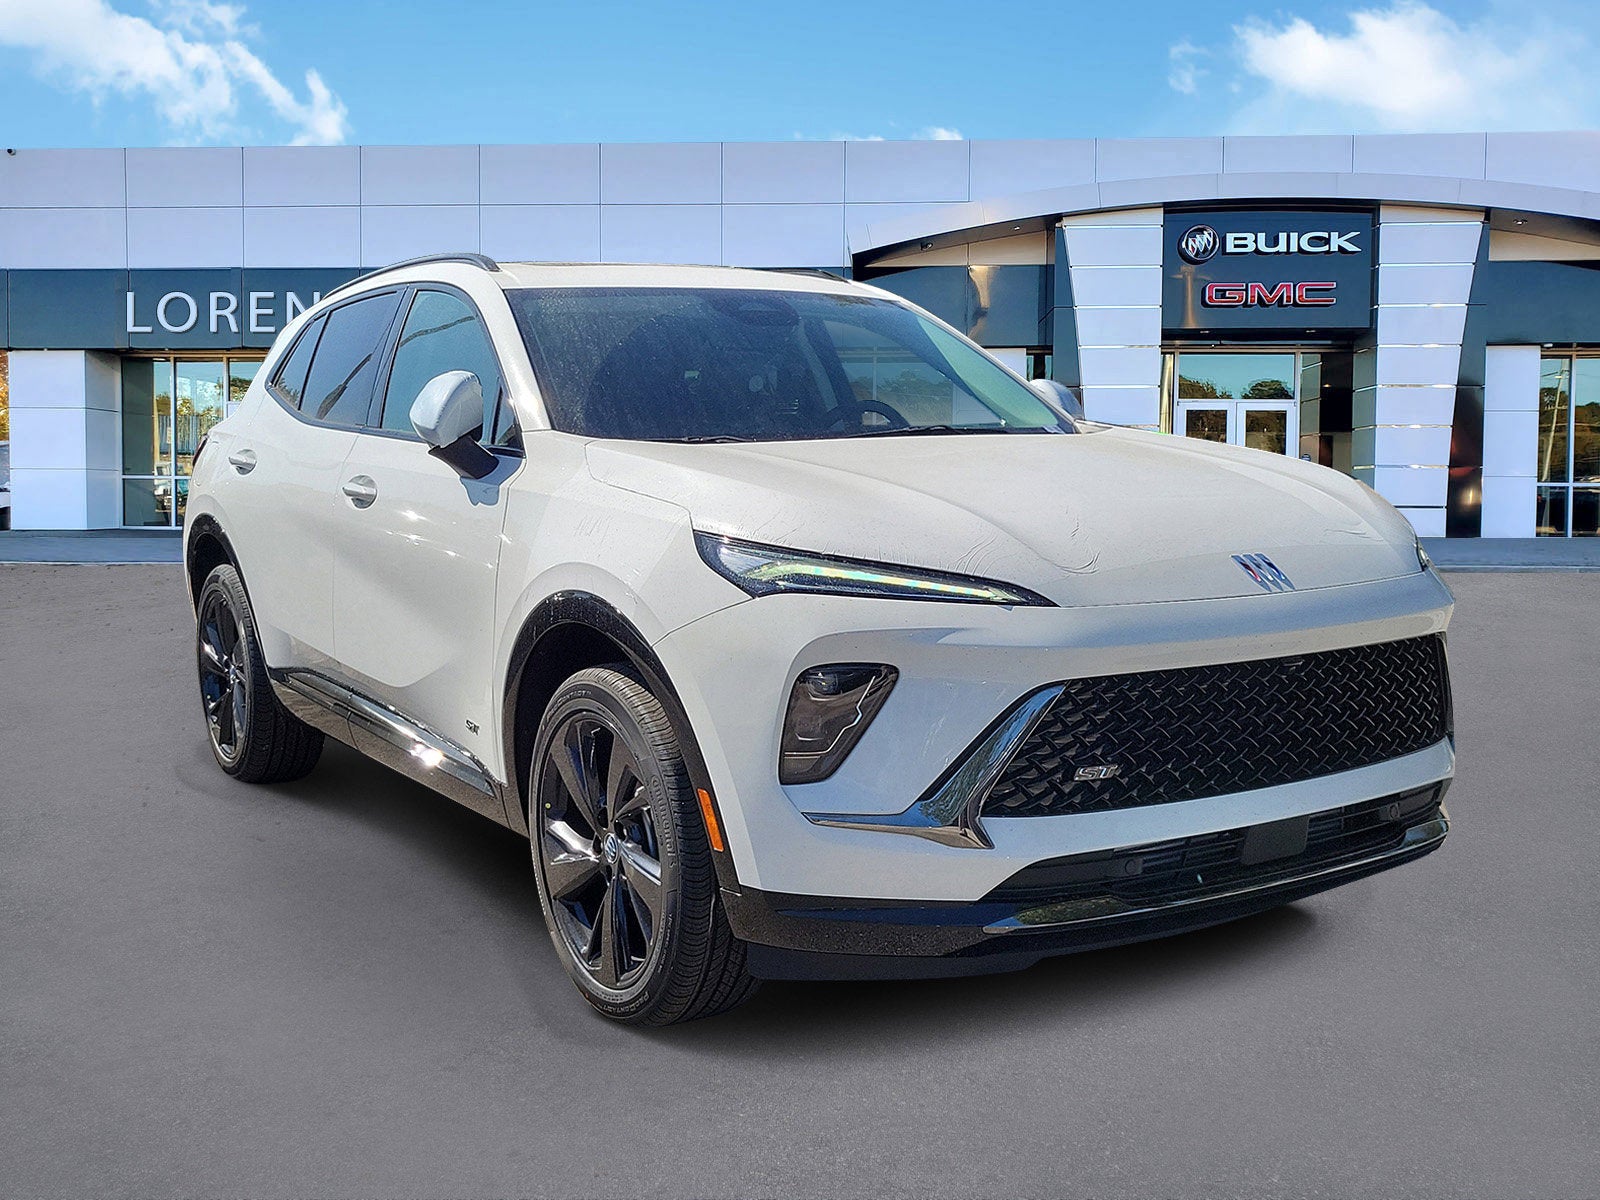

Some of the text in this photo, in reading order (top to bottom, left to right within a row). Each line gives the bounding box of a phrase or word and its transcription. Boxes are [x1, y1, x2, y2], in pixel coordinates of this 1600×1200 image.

[1225, 231, 1362, 253] BUICK
[1204, 281, 1337, 306] GMC
[1073, 764, 1119, 781] ST
